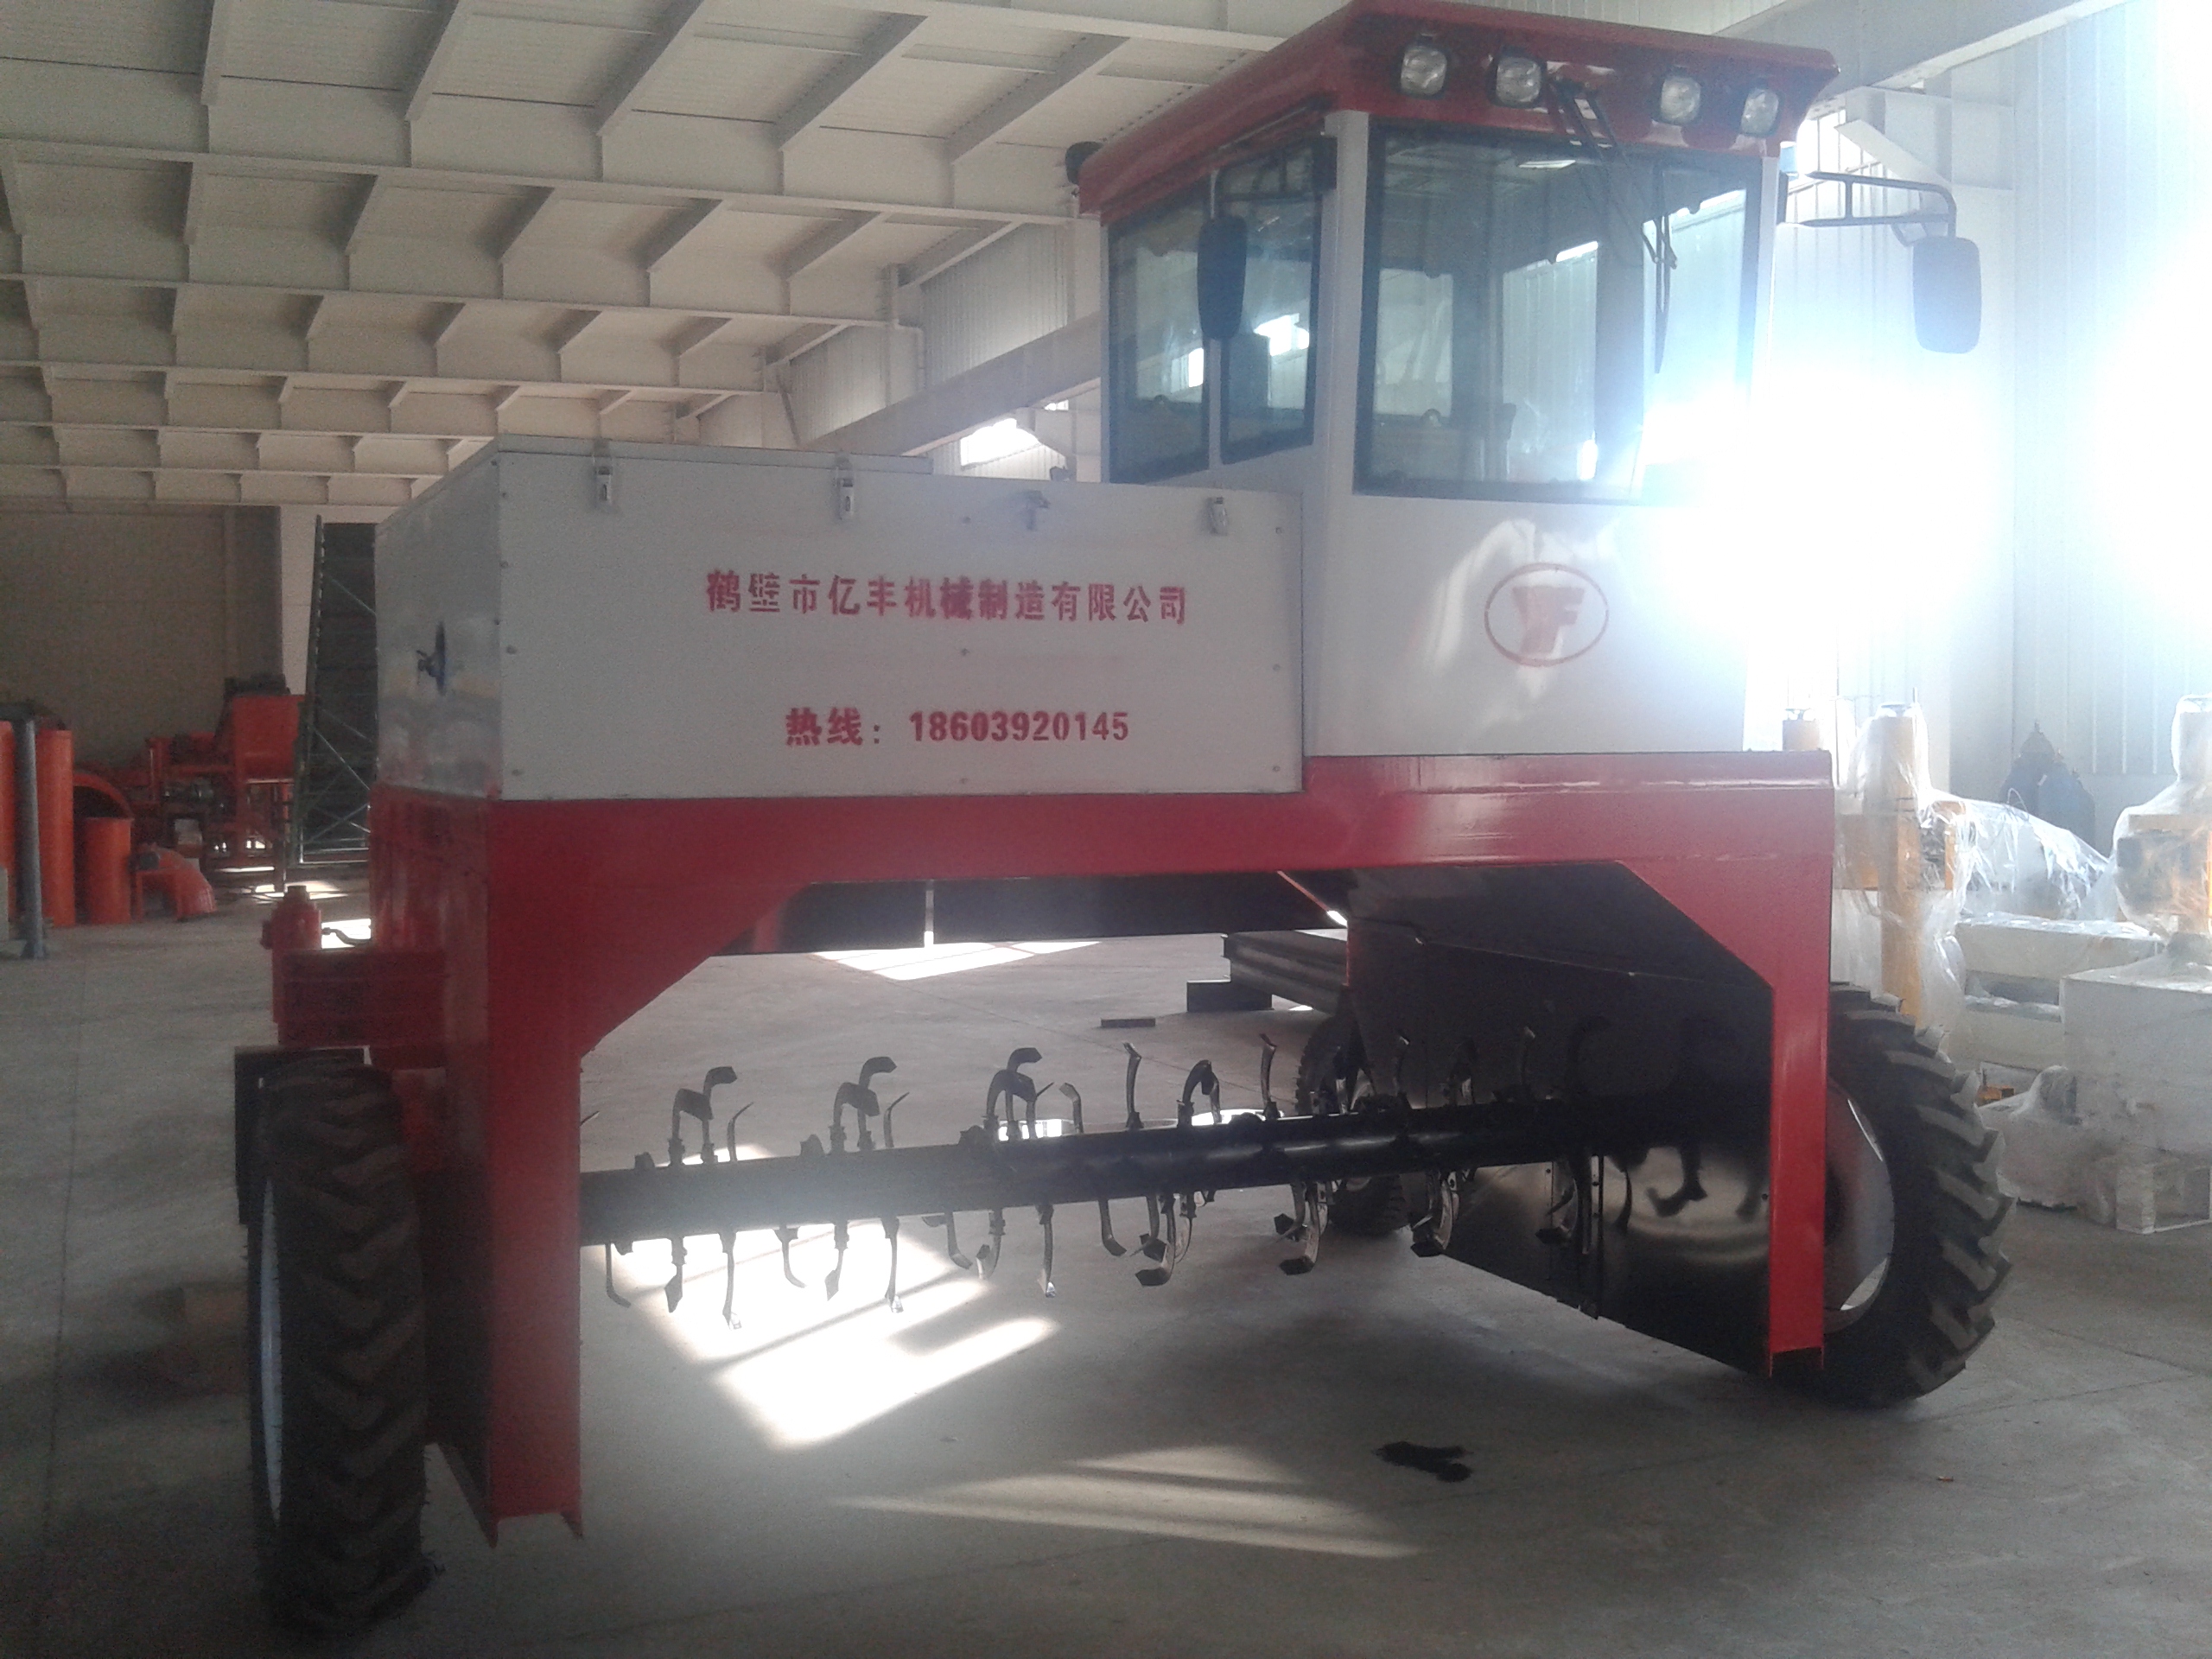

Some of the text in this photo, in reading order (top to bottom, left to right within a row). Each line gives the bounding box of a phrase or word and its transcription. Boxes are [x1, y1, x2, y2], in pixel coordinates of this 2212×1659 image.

[707, 569, 1186, 625] 鹤壁市亿丰机械制造有限公司
[909, 710, 1129, 743] 18603920145
